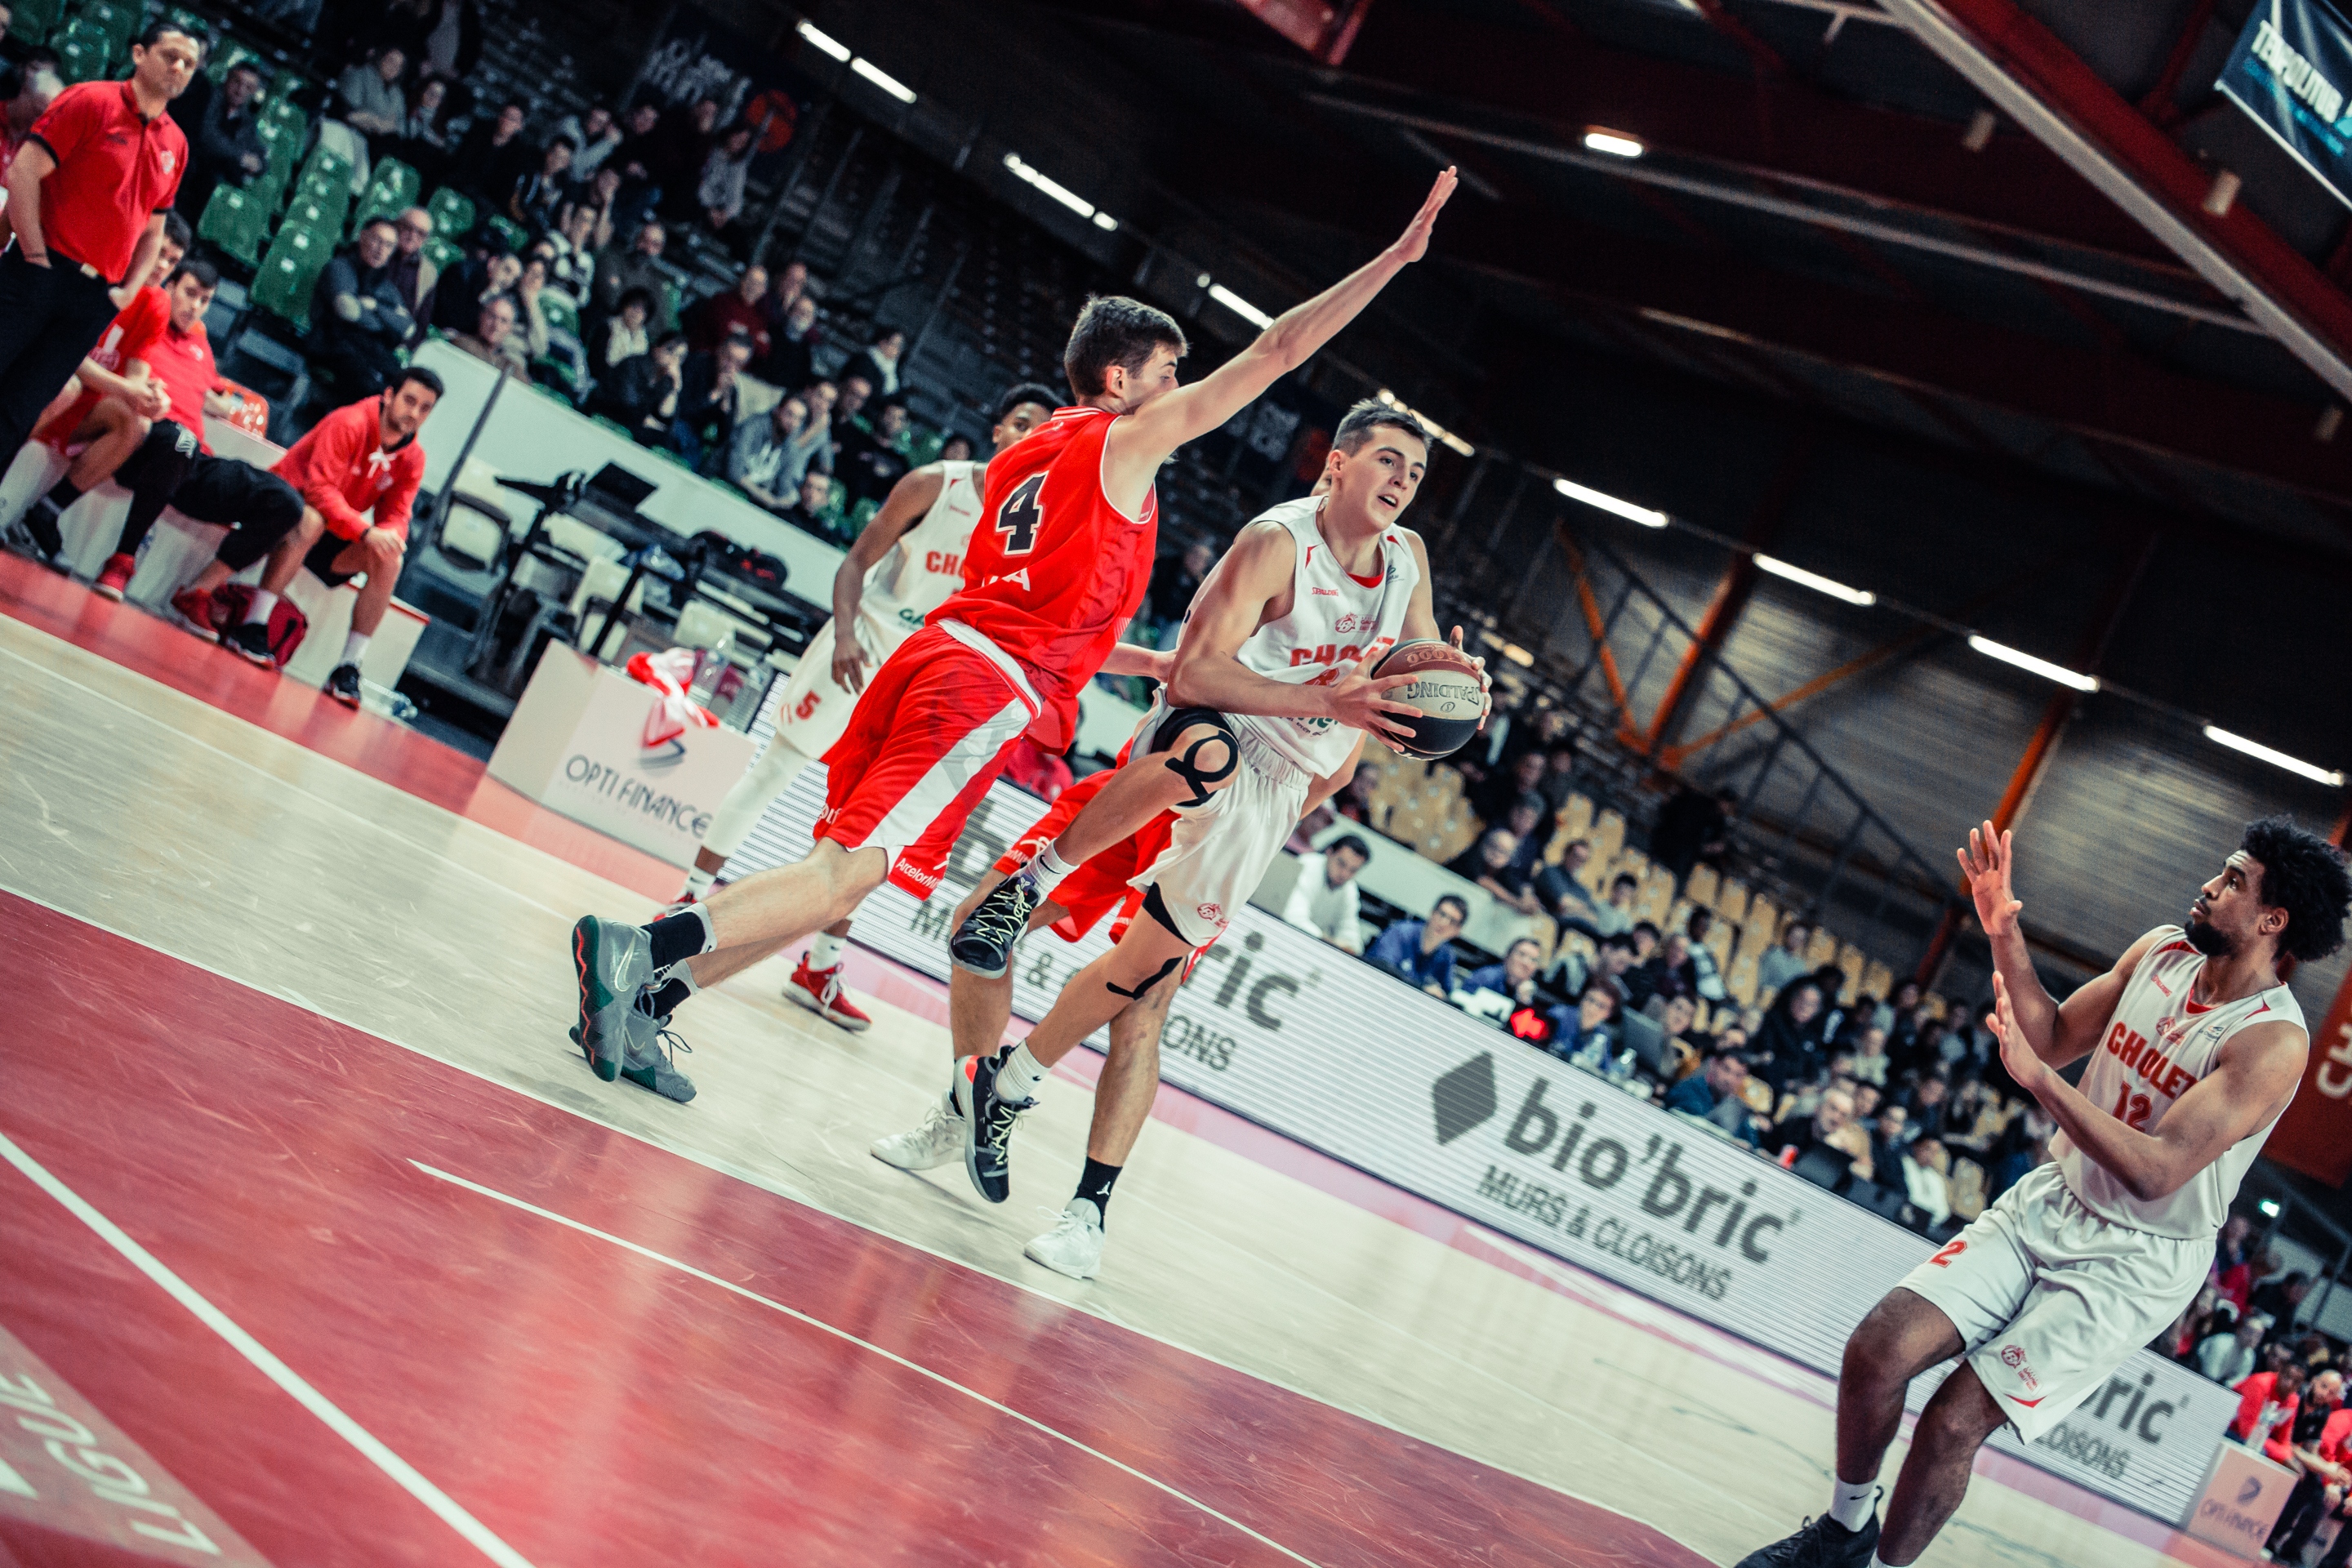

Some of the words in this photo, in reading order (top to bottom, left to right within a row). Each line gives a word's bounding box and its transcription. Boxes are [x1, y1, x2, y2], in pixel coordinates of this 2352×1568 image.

[996, 470, 1049, 556] 4
[795, 690, 822, 720] 5
[1406, 680, 1481, 706] PALDING
[566, 754, 620, 797] OPTI
[617, 778, 715, 840] FINANCE
[2113, 1080, 2153, 1132] 12
[1476, 1165, 1569, 1226] MURS
[1566, 1207, 1591, 1239] &
[1592, 1217, 1732, 1301] CLOISONS
[2035, 1422, 2130, 1479] OISONS
